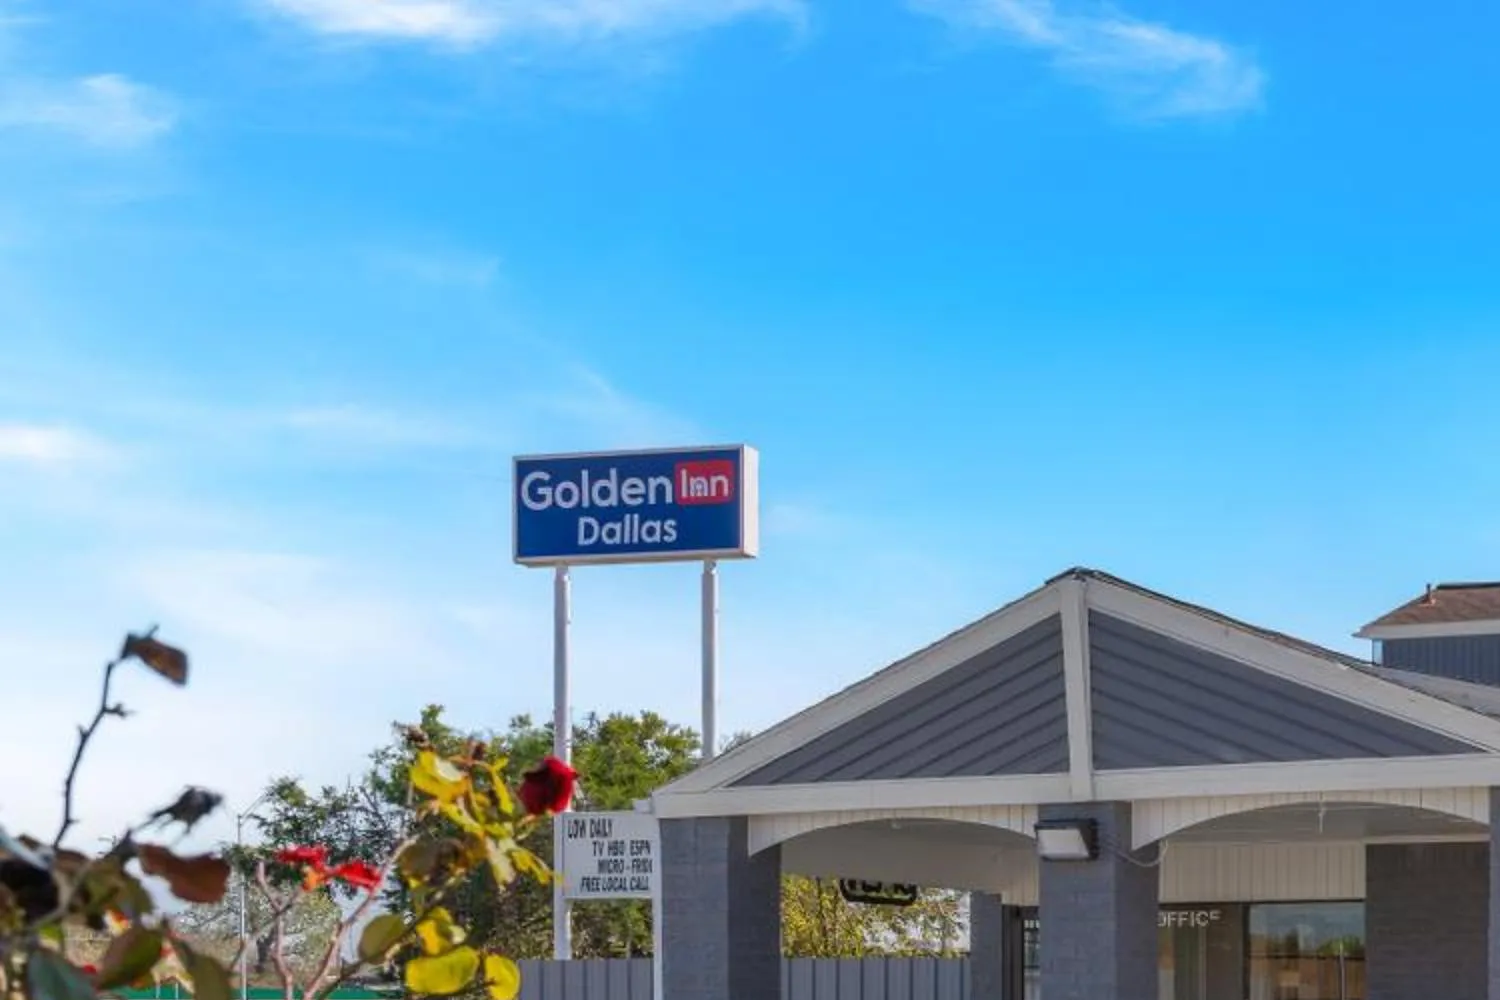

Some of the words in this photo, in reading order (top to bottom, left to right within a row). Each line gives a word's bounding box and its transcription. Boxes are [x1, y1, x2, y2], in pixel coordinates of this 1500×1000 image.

[520, 468, 673, 511] Golden
[680, 468, 729, 498] Inn
[577, 513, 677, 545] Dallas
[589, 818, 613, 838] DAILY
[592, 841, 605, 856] TV
[607, 840, 625, 856] HBO
[630, 839, 651, 856] ESPN
[598, 858, 625, 874] MICRO
[580, 876, 601, 892] FREE
[602, 876, 628, 892] LOCAL
